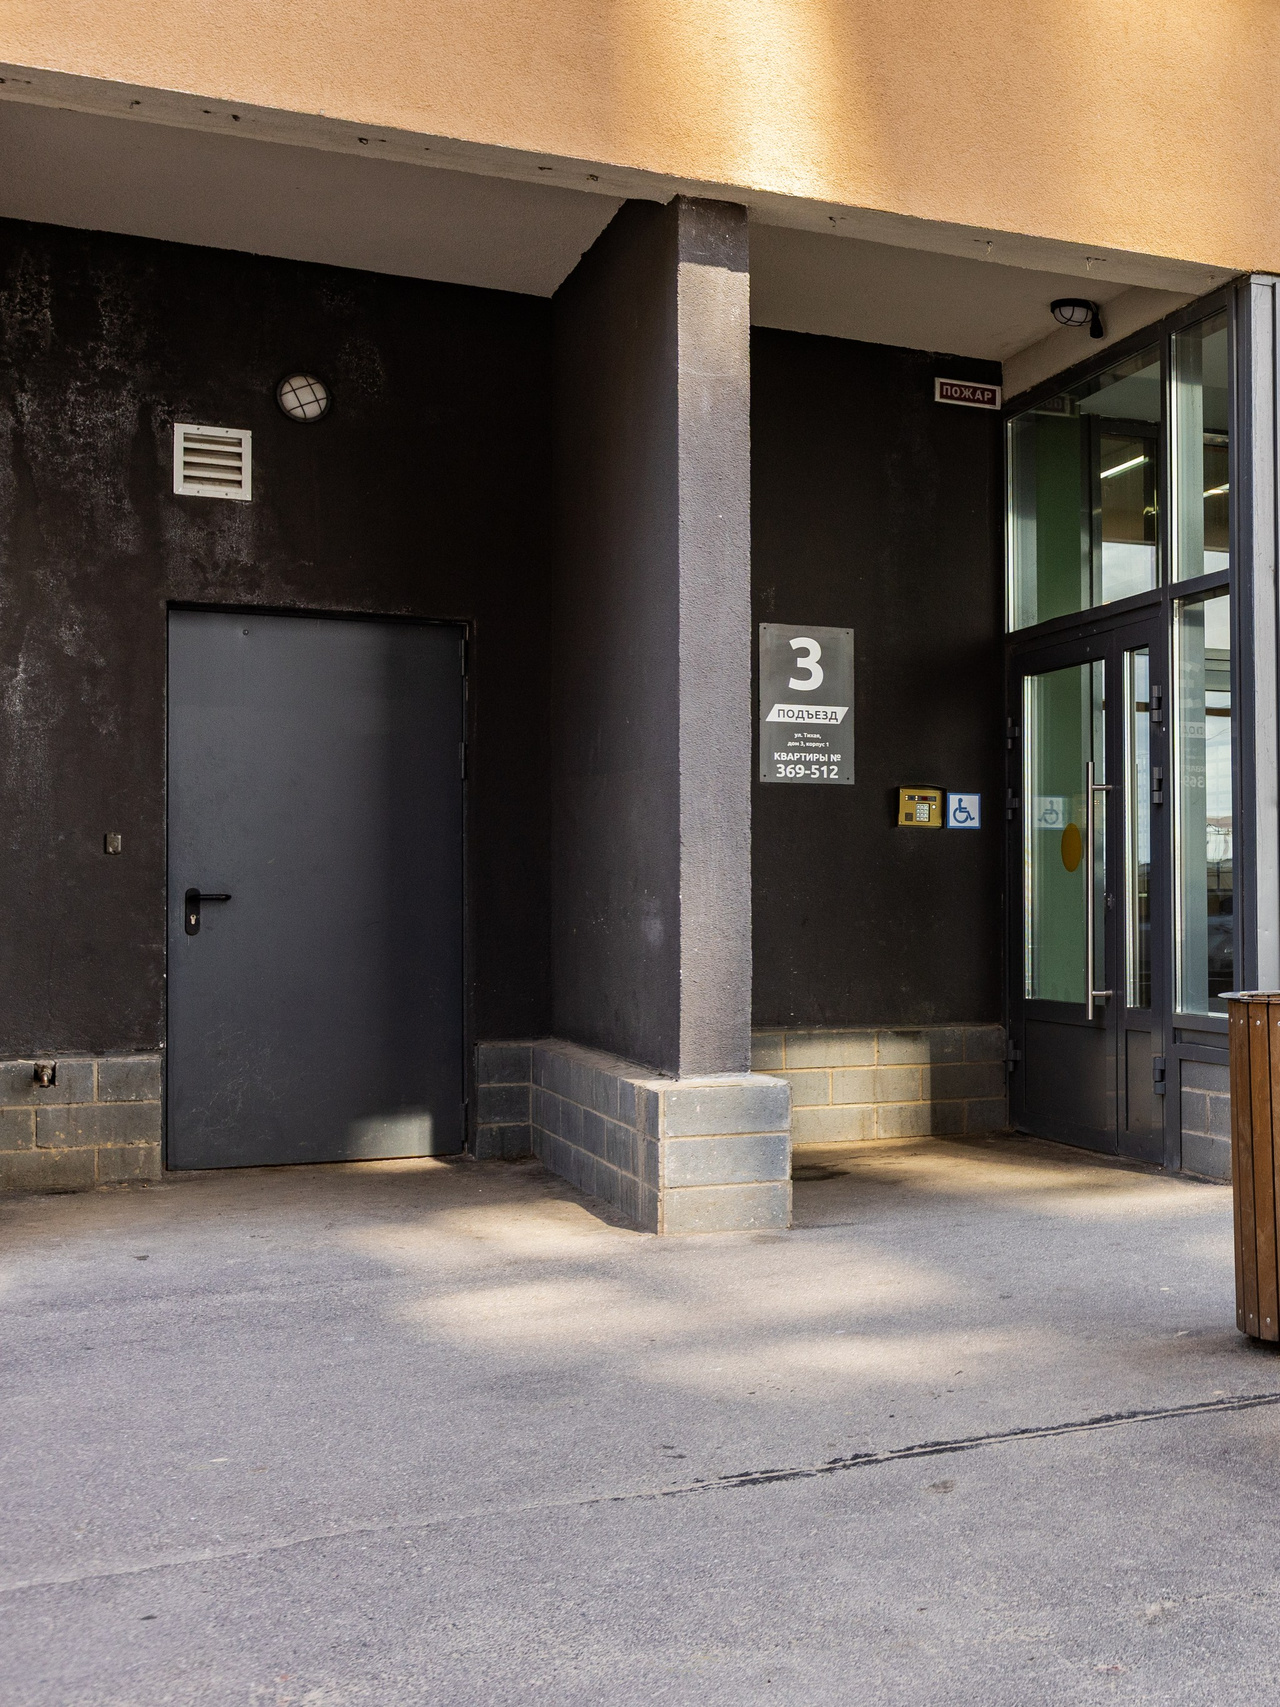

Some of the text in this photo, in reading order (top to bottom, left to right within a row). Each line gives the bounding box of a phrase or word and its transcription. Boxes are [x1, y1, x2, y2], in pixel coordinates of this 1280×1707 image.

[942, 385, 993, 401] ПОЖАР
[788, 636, 824, 691] 3
[777, 708, 839, 723] ПОДЪЕЗД
[774, 752, 841, 762] КВАРТИРЫ №
[776, 764, 839, 779] 369-512
